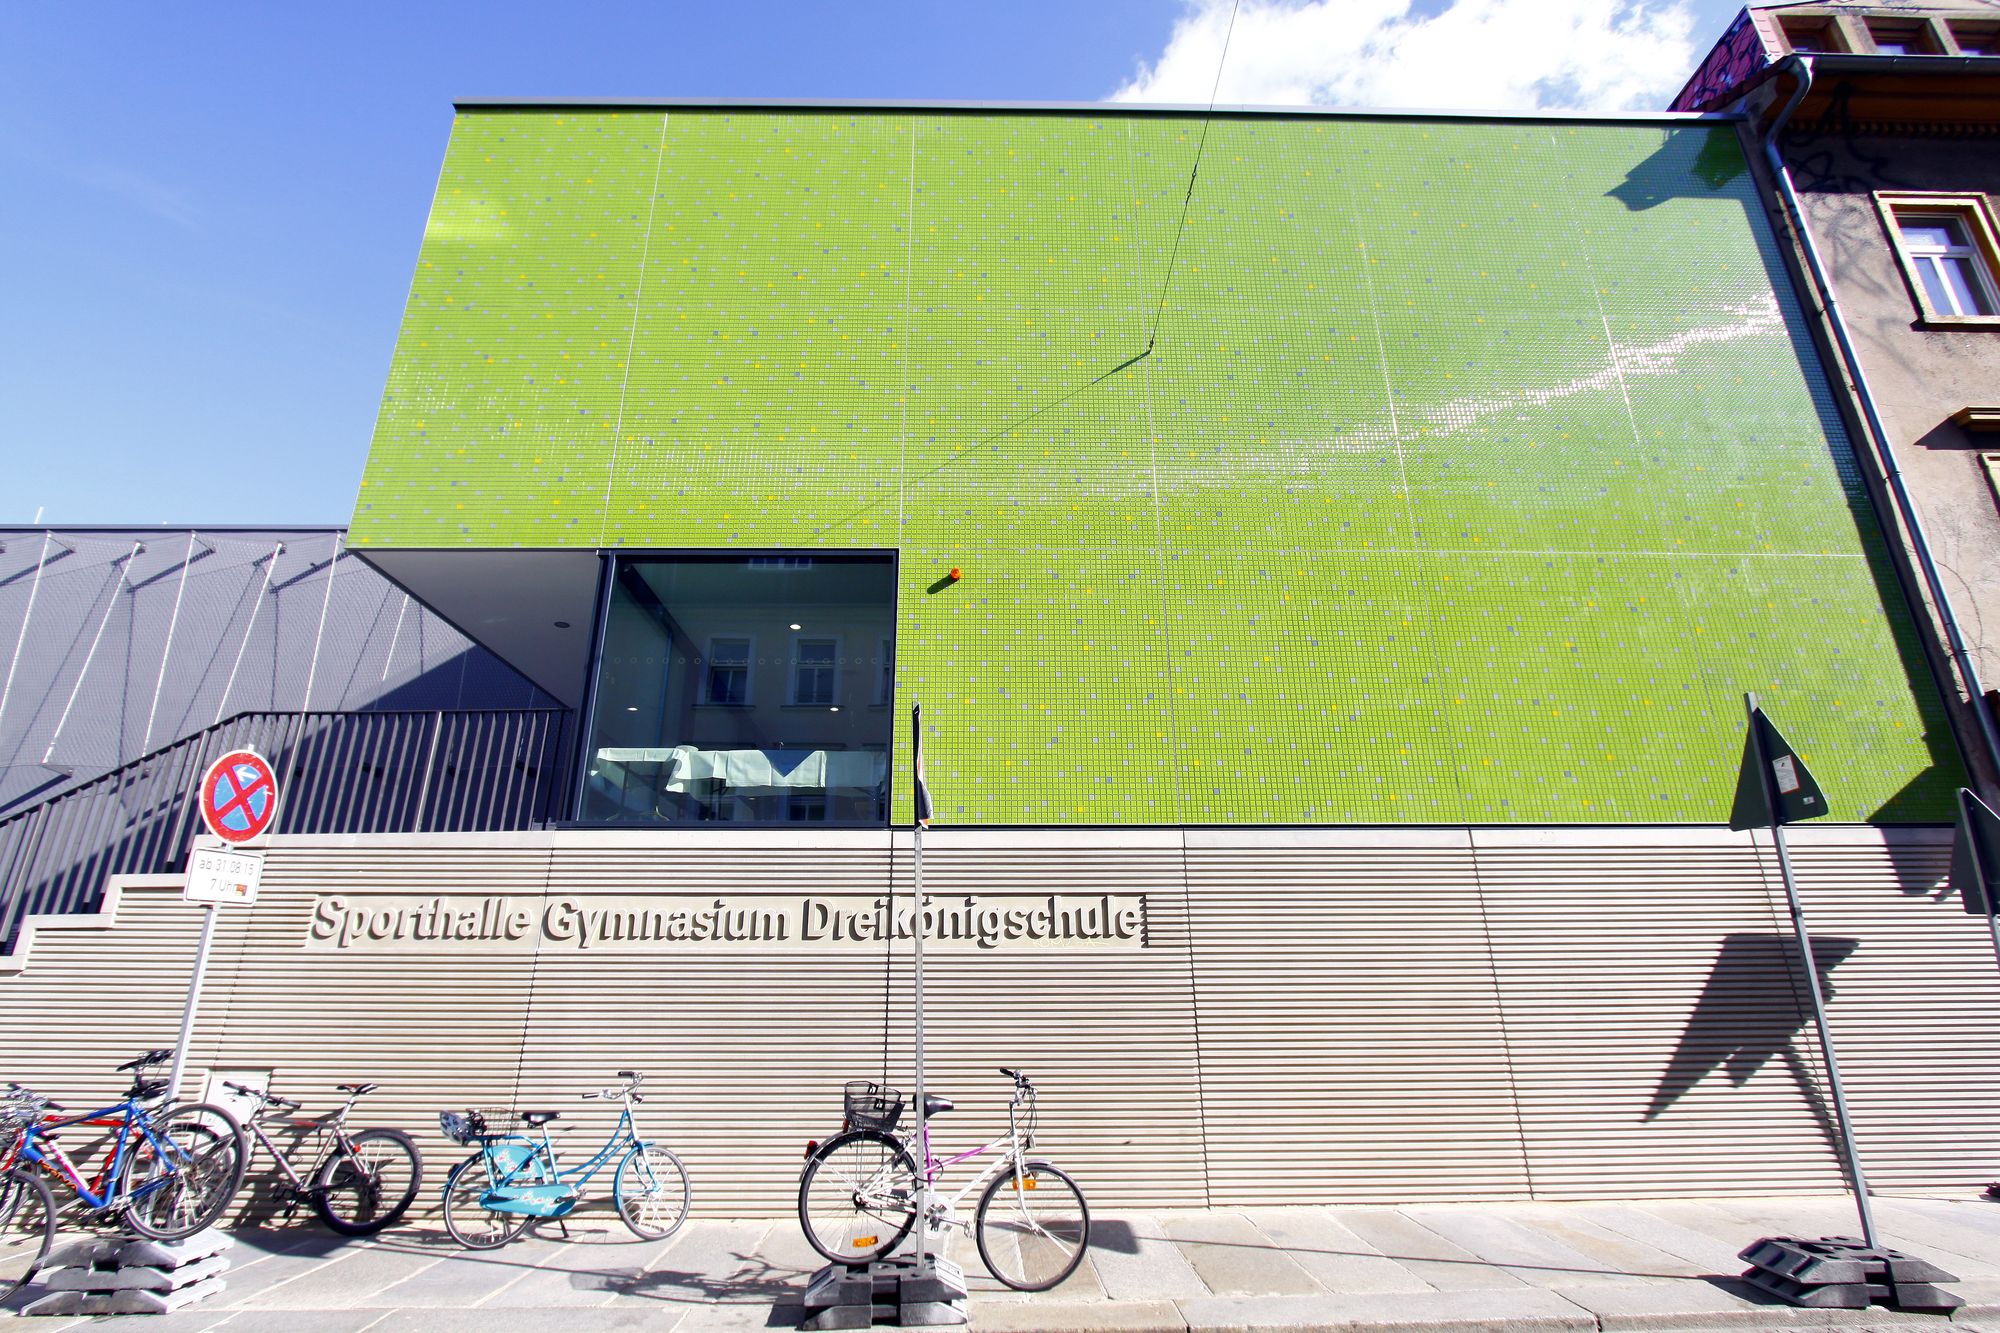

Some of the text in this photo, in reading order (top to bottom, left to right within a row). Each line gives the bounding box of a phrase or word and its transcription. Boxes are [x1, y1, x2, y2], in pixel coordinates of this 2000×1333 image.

[199, 858, 213, 870] ab
[210, 878, 217, 890] 7
[312, 895, 1143, 949] Sporthalle Gymnasium Dreikönigschule
